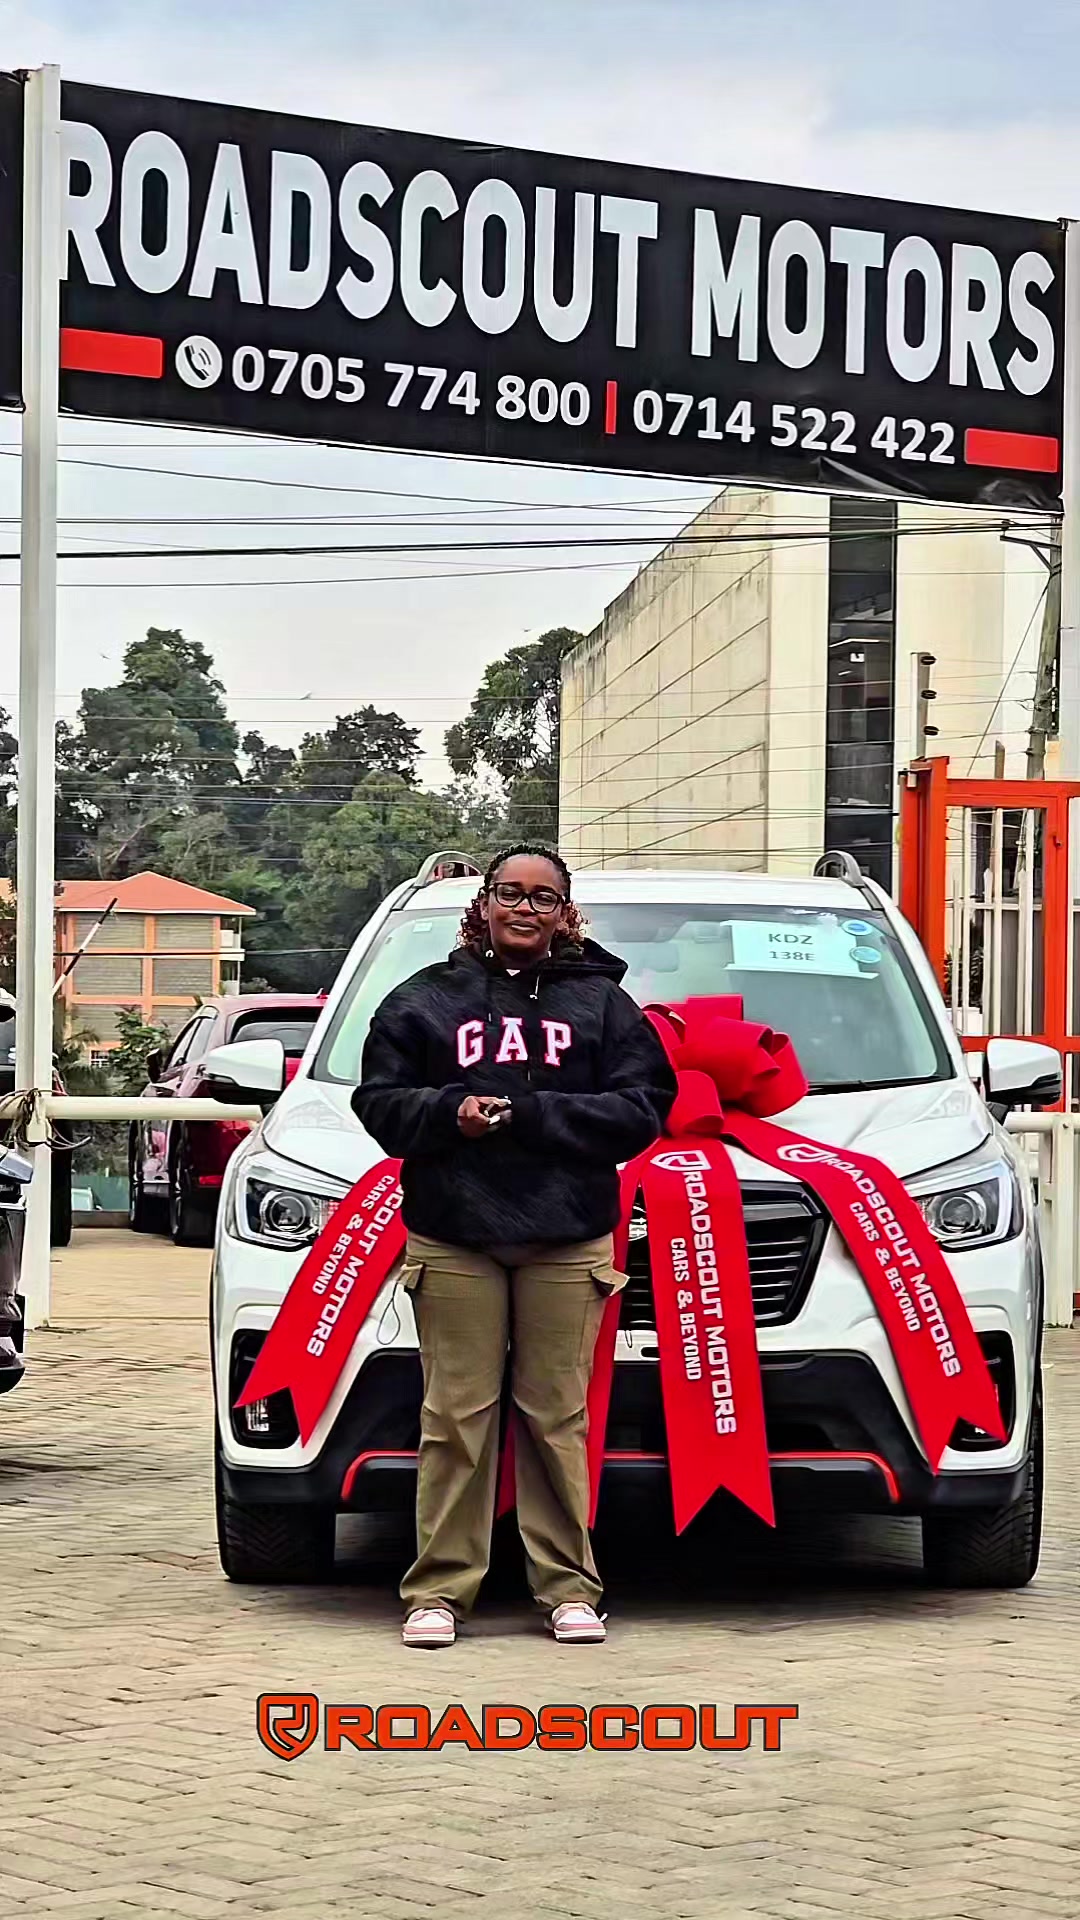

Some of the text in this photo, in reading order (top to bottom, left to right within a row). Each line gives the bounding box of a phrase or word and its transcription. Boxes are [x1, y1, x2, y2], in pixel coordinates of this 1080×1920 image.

[61, 120, 1056, 396] ROADSCOUT MOTORS
[232, 345, 956, 465] 0705 774 800 0714 522 422
[768, 933, 814, 945] KDZ
[770, 951, 815, 961] 138E
[456, 1016, 572, 1068] GAP
[312, 1175, 396, 1295] CARS & BEYOND
[820, 1157, 961, 1377] ROADSCOUT MOTORS
[849, 1201, 921, 1331] CARS & BEYOND
[306, 1255, 365, 1357] MOTORS
[670, 1237, 702, 1380] CARS & BEYOND
[682, 1170, 737, 1434] ROADSCOUT MOTORS
